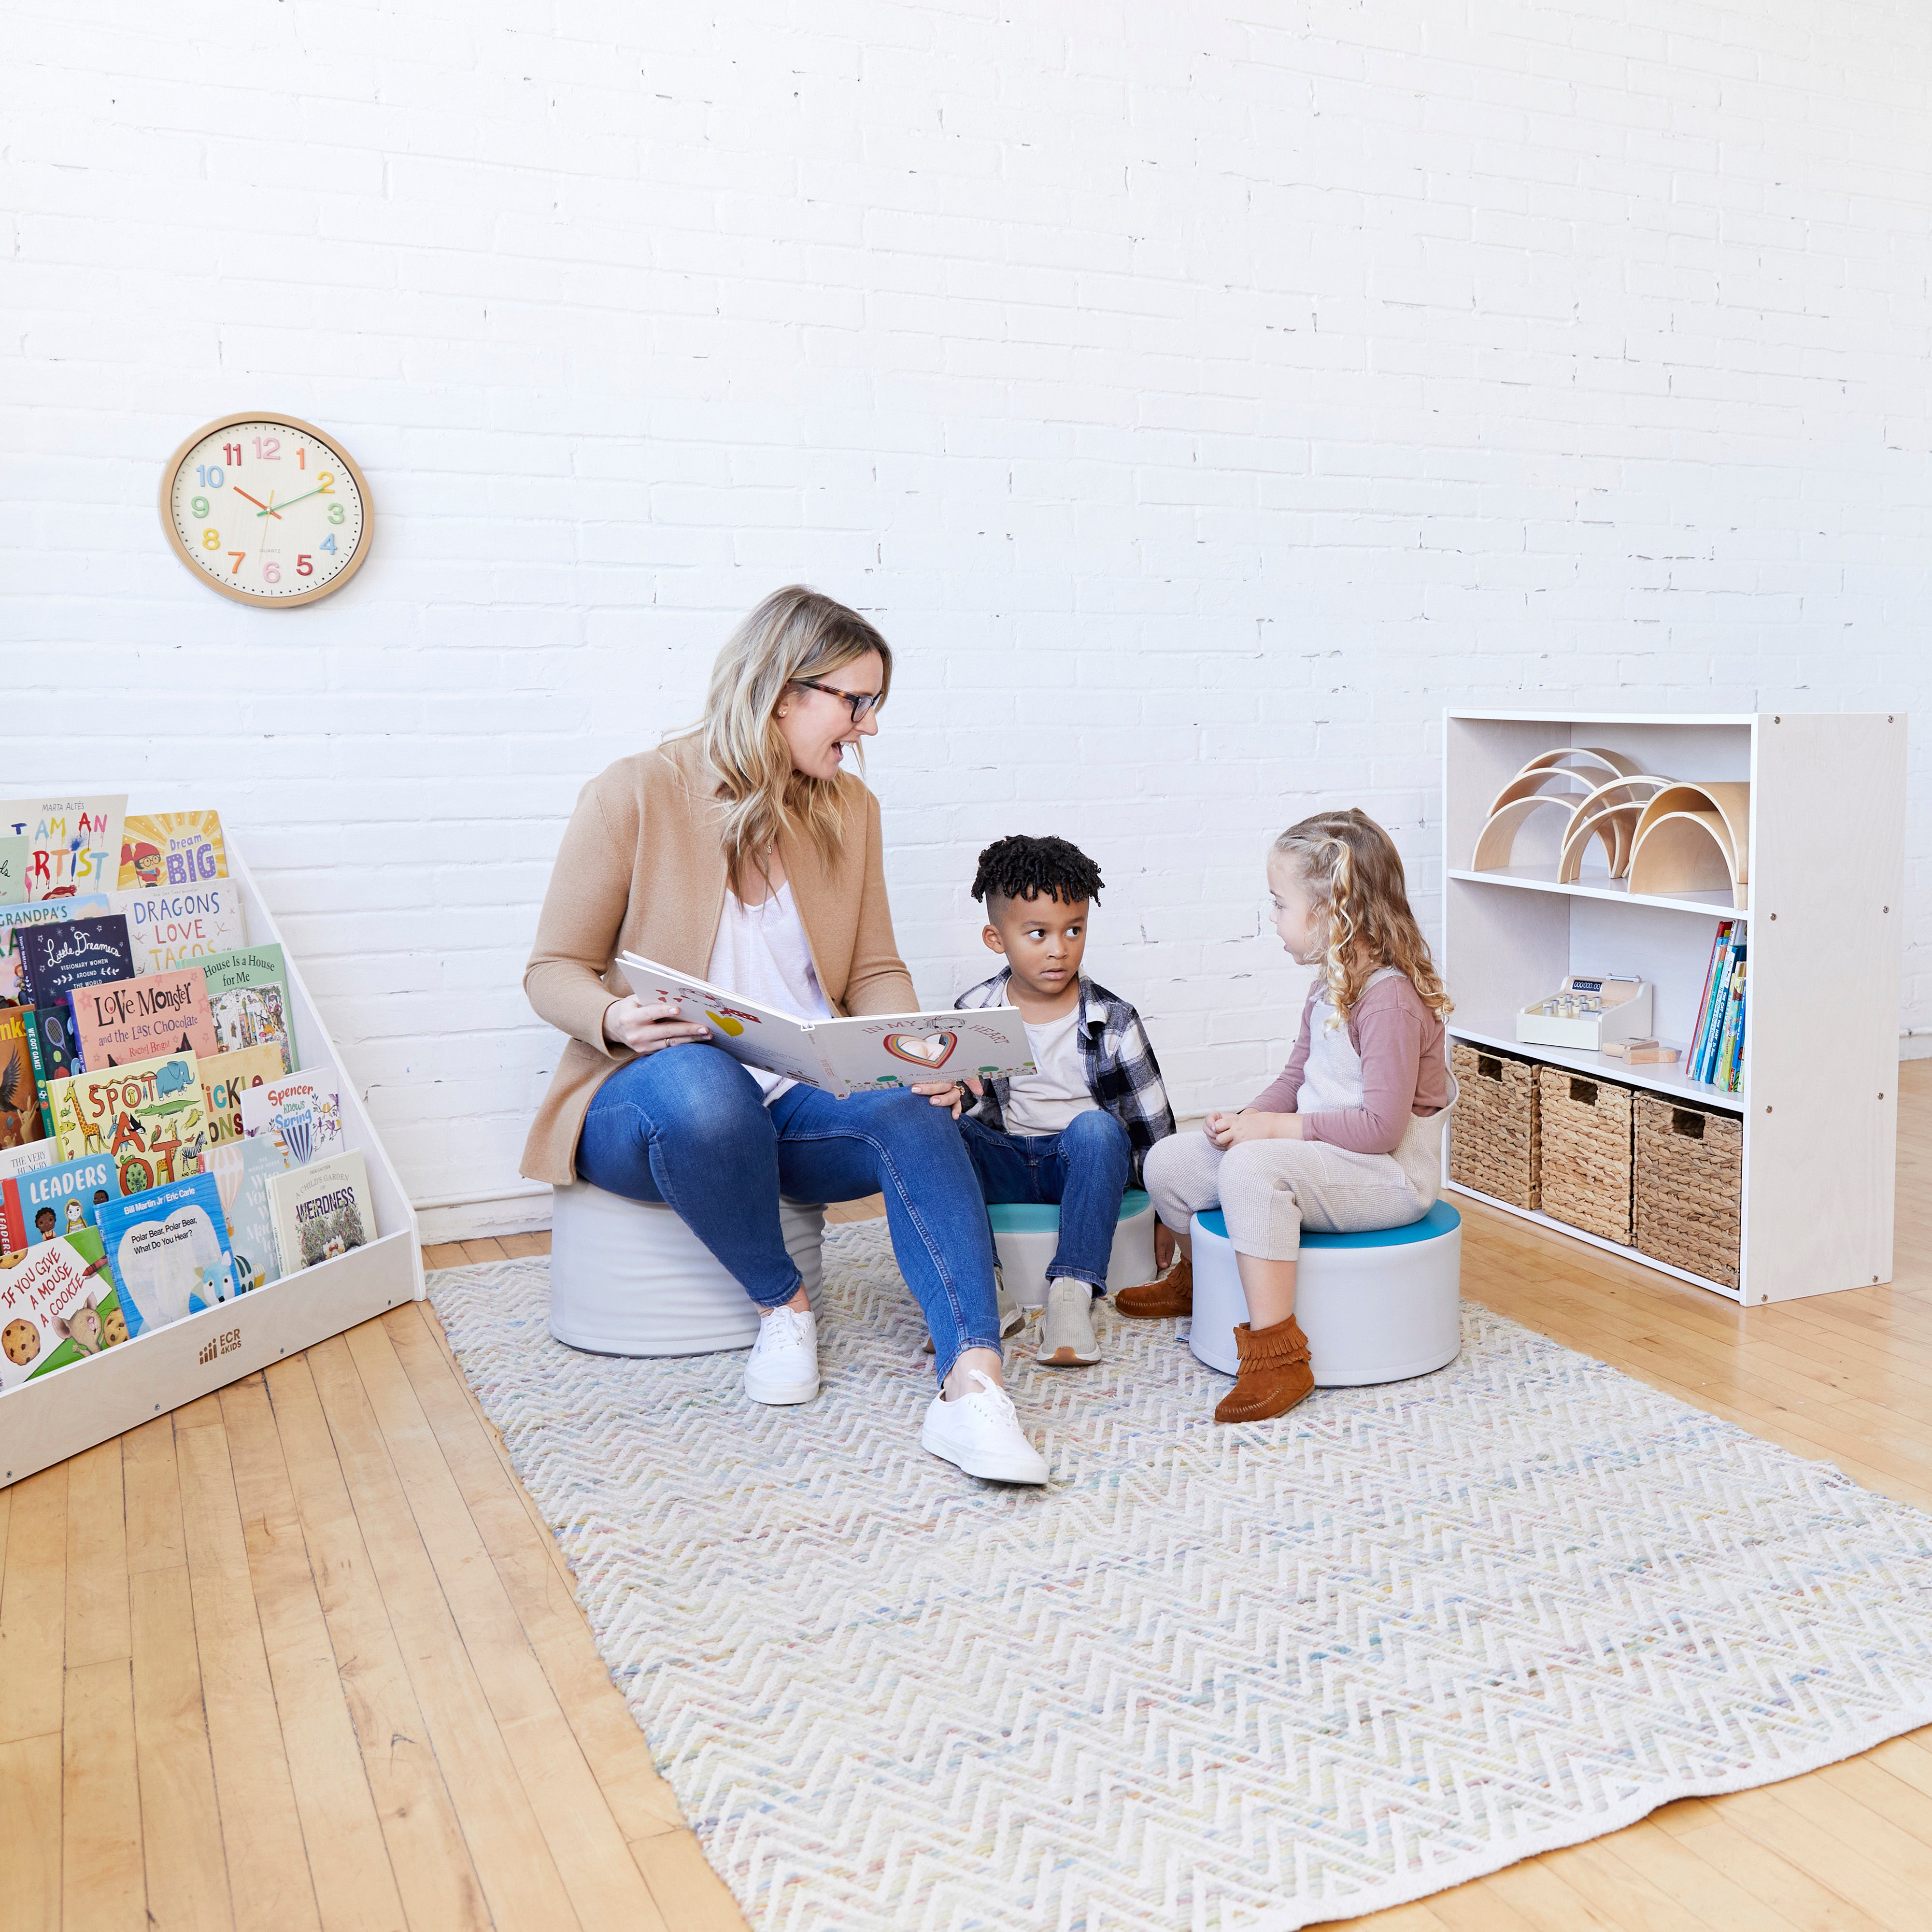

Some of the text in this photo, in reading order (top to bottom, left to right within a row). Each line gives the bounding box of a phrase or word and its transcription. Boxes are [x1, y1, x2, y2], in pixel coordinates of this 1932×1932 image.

[223, 443, 241, 466] 11
[252, 437, 280, 460] 12
[296, 448, 305, 469] 1
[196, 465, 224, 488] 10
[317, 472, 334, 493] 2
[191, 496, 209, 518] 9
[327, 503, 344, 525] 3
[202, 528, 220, 550] 8
[319, 533, 337, 554] 4
[228, 552, 245, 573] 7
[263, 561, 280, 583] 6
[296, 554, 313, 576] 5
[42, 801, 85, 812] MARTA ALTÉS
[35, 816, 66, 843] AM
[79, 812, 107, 836] AN
[170, 835, 201, 851] Dream
[166, 843, 216, 884] BIG
[134, 892, 219, 924] DRAGONS
[155, 919, 205, 944] LOVE
[43, 931, 121, 967] Little Dreamers
[60, 962, 88, 971] VISIONARY
[77, 970, 97, 979] AROUND
[203, 960, 230, 979] House
[232, 956, 240, 966] Is
[248, 955, 275, 971] House
[223, 971, 250, 986] for Me
[99, 1034, 113, 1046] and
[114, 1029, 129, 1043] the
[861, 1020, 1010, 1044] IN MY HEART
[28, 1027, 42, 1070] WE GOT GAME!
[129, 1041, 170, 1057] Rachel Bright
[89, 1075, 157, 1118] SPOT
[268, 1085, 313, 1106] Spencer
[284, 1100, 305, 1114] knows
[275, 1109, 313, 1129] Spring
[111, 1111, 145, 1157] A
[11, 1151, 46, 1168] THE VERY
[120, 1139, 182, 1196] OT
[30, 1164, 107, 1204] LEADERS
[181, 1170, 190, 1178] AND
[300, 1176, 323, 1193] CHILD'S
[323, 1173, 349, 1182] GARDEN
[124, 1205, 135, 1215] Bill
[135, 1200, 156, 1211] Martin
[166, 1192, 179, 1202] Eric
[179, 1188, 195, 1198] Carle
[296, 1186, 355, 1223] WEIRDNESS
[0, 1213, 12, 1255] LEADERS
[131, 1218, 197, 1244] Polar Bear, Polar Bear,
[134, 1244, 151, 1254] What
[161, 1236, 174, 1245] You
[174, 1229, 192, 1241] Hear?
[1, 1247, 60, 1309] IF YOU GIVE
[30, 1262, 72, 1310] A MOUSE
[40, 1273, 84, 1328] A COOKIE
[220, 1328, 240, 1347] ECR
[221, 1340, 242, 1355] 4KIDS
